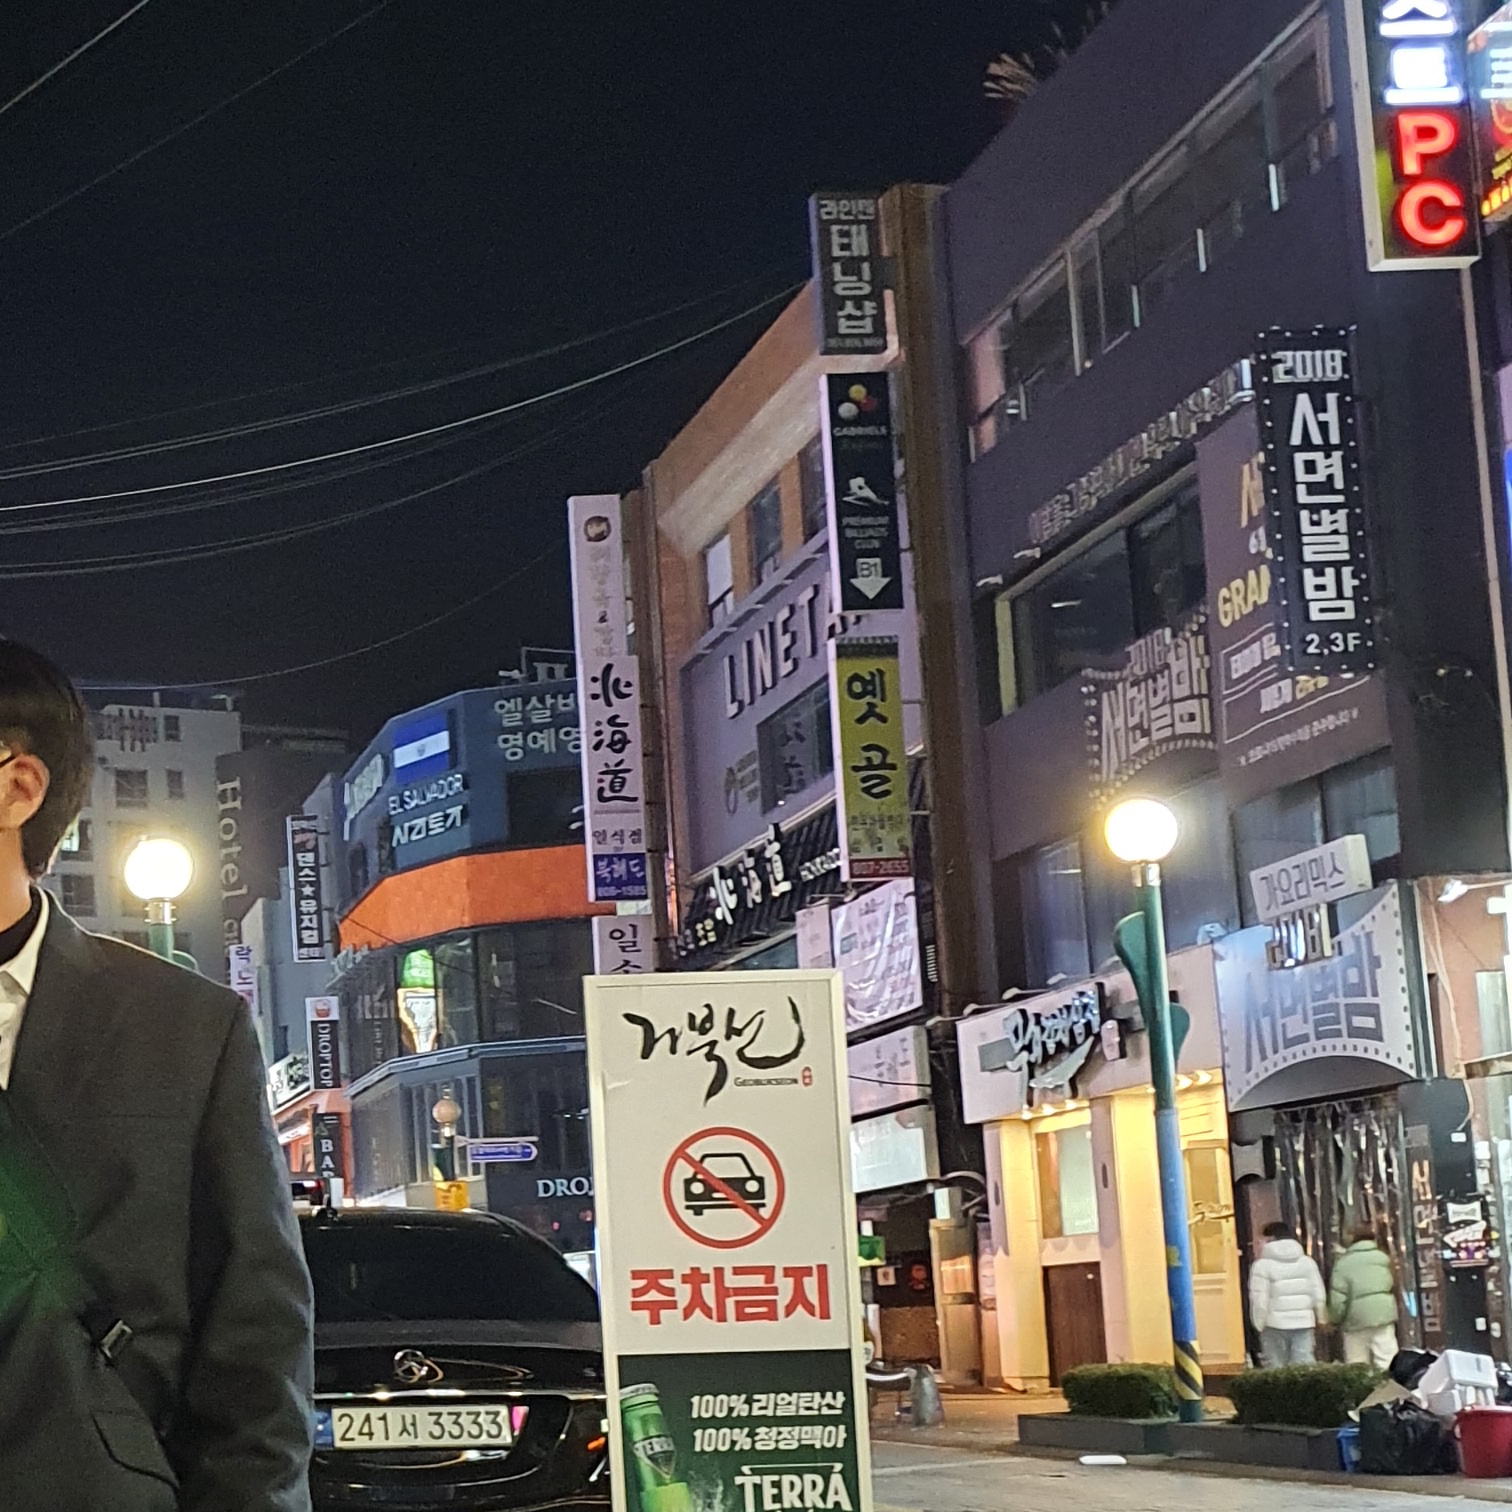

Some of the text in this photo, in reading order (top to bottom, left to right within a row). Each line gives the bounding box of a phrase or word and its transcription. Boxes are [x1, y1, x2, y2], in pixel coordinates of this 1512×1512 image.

[1397, 113, 1465, 246] PC
[829, 224, 878, 335] 태닝샵
[1272, 349, 1345, 384] 2018
[1289, 392, 1360, 622] 서면별밤
[859, 560, 880, 578] B1
[590, 662, 641, 804] 北海道
[846, 667, 899, 800] 옛골
[216, 775, 248, 900] Hotel
[1259, 851, 1346, 912] 가요리믹스
[316, 1023, 335, 1088] DROPTOP
[321, 1138, 335, 1176] BA
[536, 1176, 594, 1198] DRO
[629, 1263, 832, 1326] 주차금지
[427, 1410, 505, 1441] 3333
[689, 1390, 846, 1419] 100% 리얼탄산
[692, 1424, 848, 1453] 100% 청정맥아
